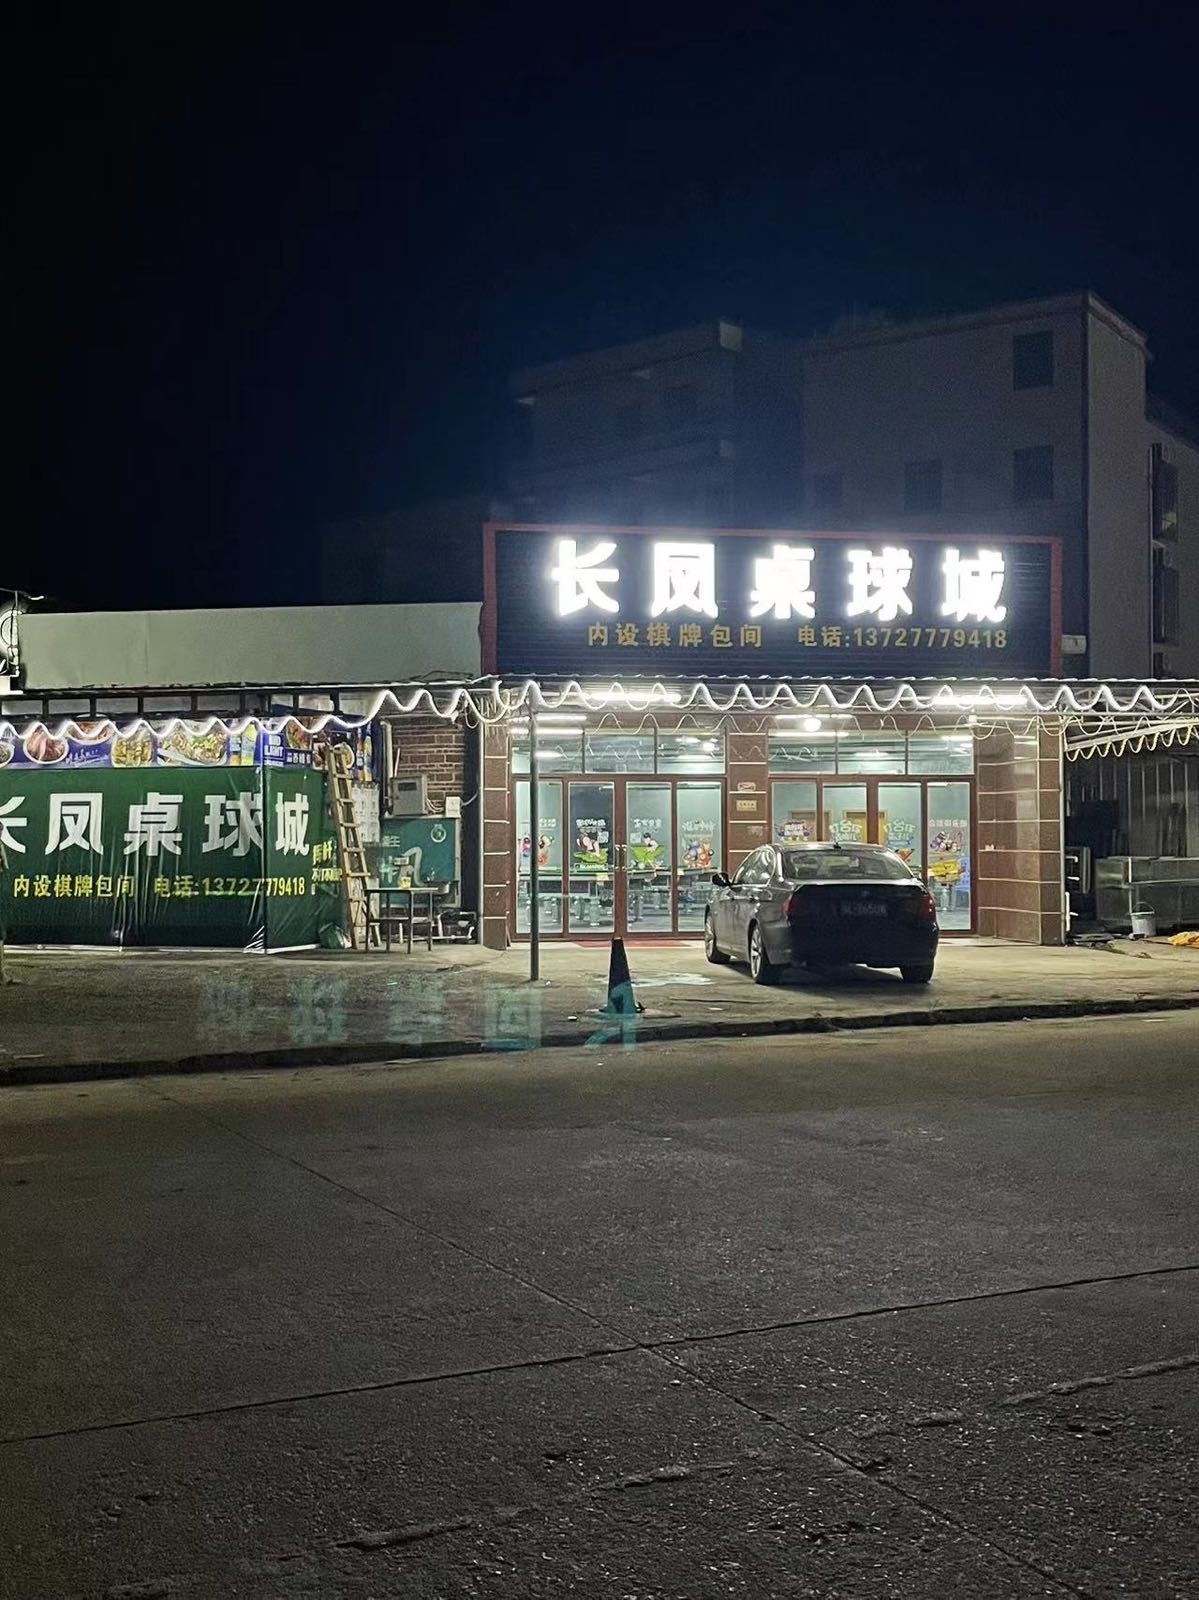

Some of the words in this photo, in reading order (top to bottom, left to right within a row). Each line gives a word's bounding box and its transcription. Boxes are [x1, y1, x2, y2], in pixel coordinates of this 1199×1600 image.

[551, 539, 1008, 623] 长凤桌球城
[587, 622, 763, 649] 内设棋牌包间
[797, 625, 1009, 650] 电话:13727779418
[13, 874, 136, 898] 内设棋牌包间
[154, 874, 305, 899] 电话:13727779418
